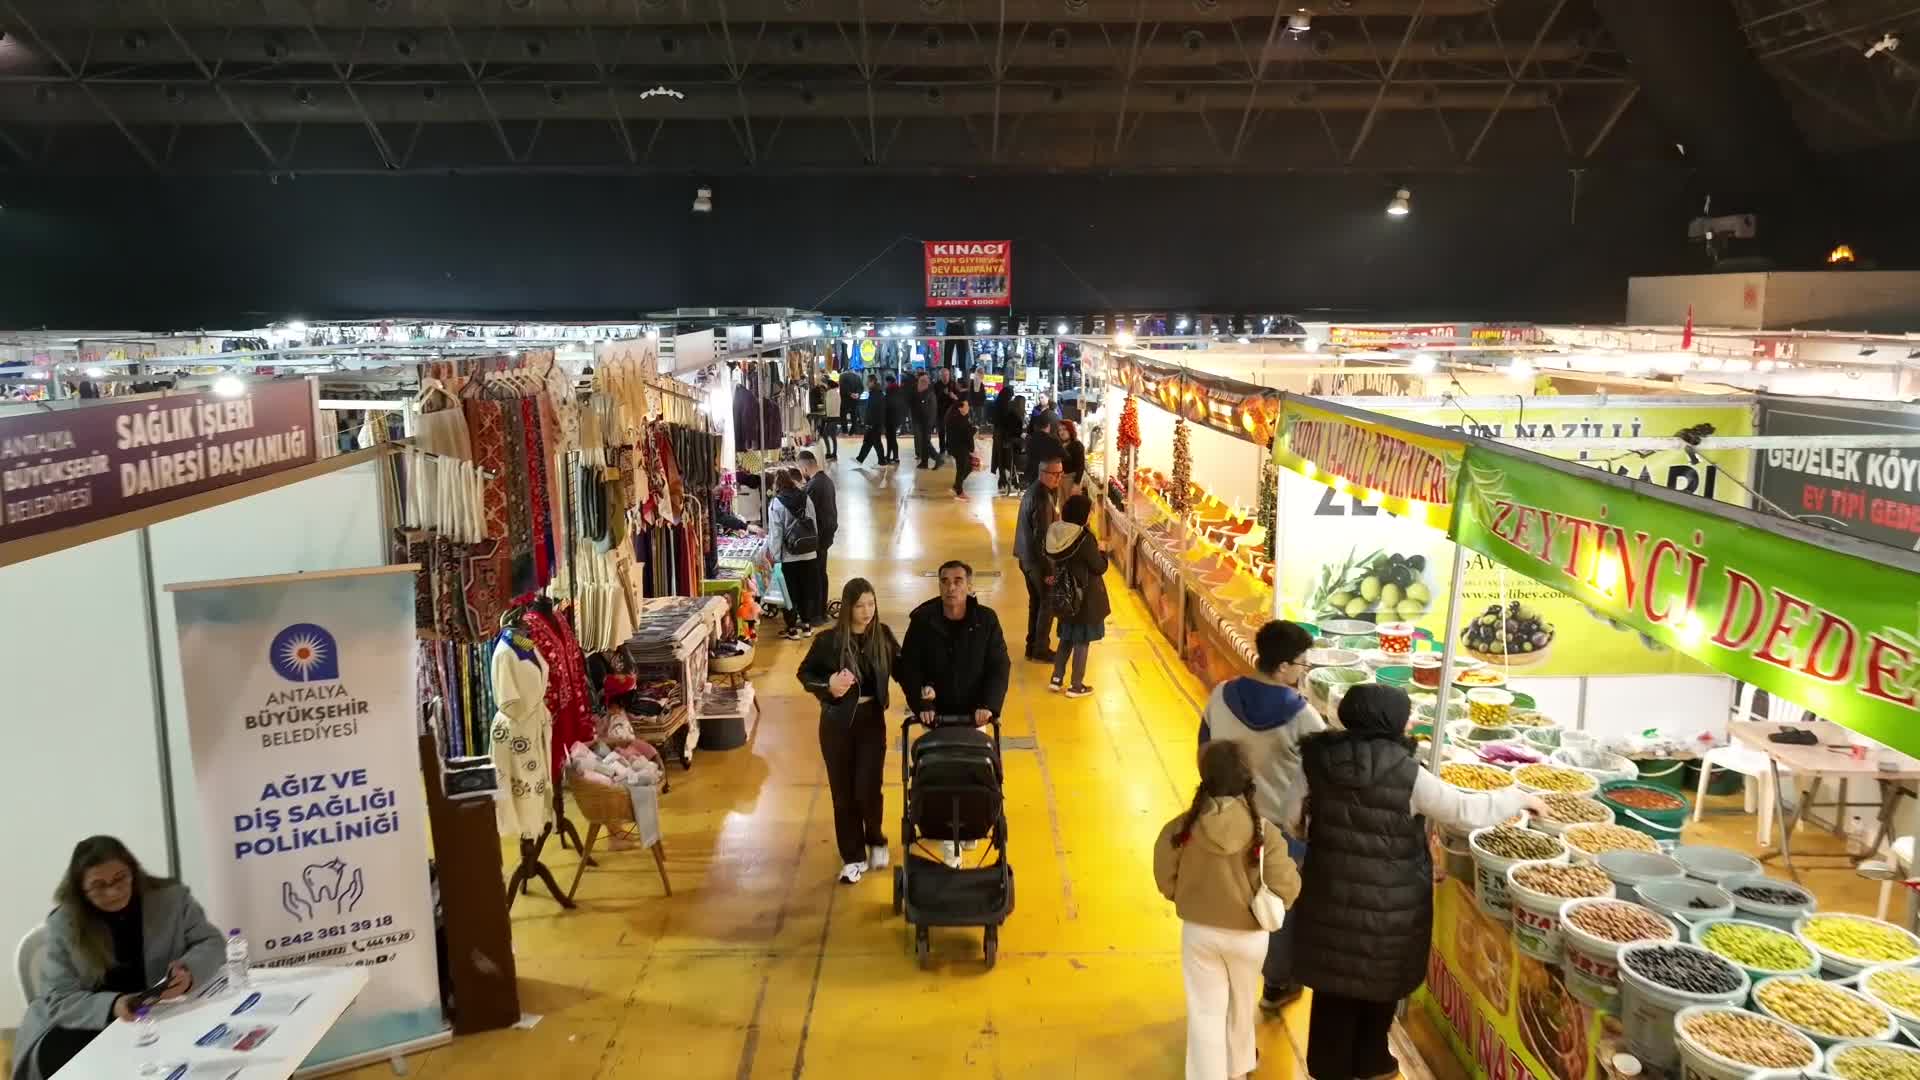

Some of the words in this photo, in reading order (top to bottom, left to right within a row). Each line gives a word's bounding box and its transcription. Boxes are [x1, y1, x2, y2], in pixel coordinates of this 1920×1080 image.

[933, 244, 1004, 255] KINACI
[931, 265, 951, 274] DEV
[116, 404, 195, 449] SAĞLIK
[195, 393, 254, 439] İŞLERİ
[2, 450, 111, 492] BÜYÜKŞEHİR
[119, 442, 205, 498] DAİRESİ
[207, 424, 306, 476] BAŞKANLIĞI
[1767, 447, 1862, 483] GEDELEK
[1865, 449, 1920, 493] KÖY
[1802, 483, 1826, 512] EV
[1489, 499, 1709, 628] ZEYTİNCİ
[1709, 565, 1919, 711] DEDE
[265, 683, 348, 706] ANTALYA
[245, 698, 369, 730] BÜYÜKŞEHİR
[261, 718, 358, 748] BELEDİYESİ
[260, 773, 327, 801] AĞIZ
[331, 768, 368, 789] VE
[234, 806, 282, 833] DİŞ
[288, 786, 396, 823] SAĞLIĞI
[234, 810, 399, 860] POLİKLİNİĞİ
[265, 938, 277, 950] 0
[280, 931, 314, 948] 242
[317, 924, 347, 939] 361
[375, 914, 393, 928] 18
